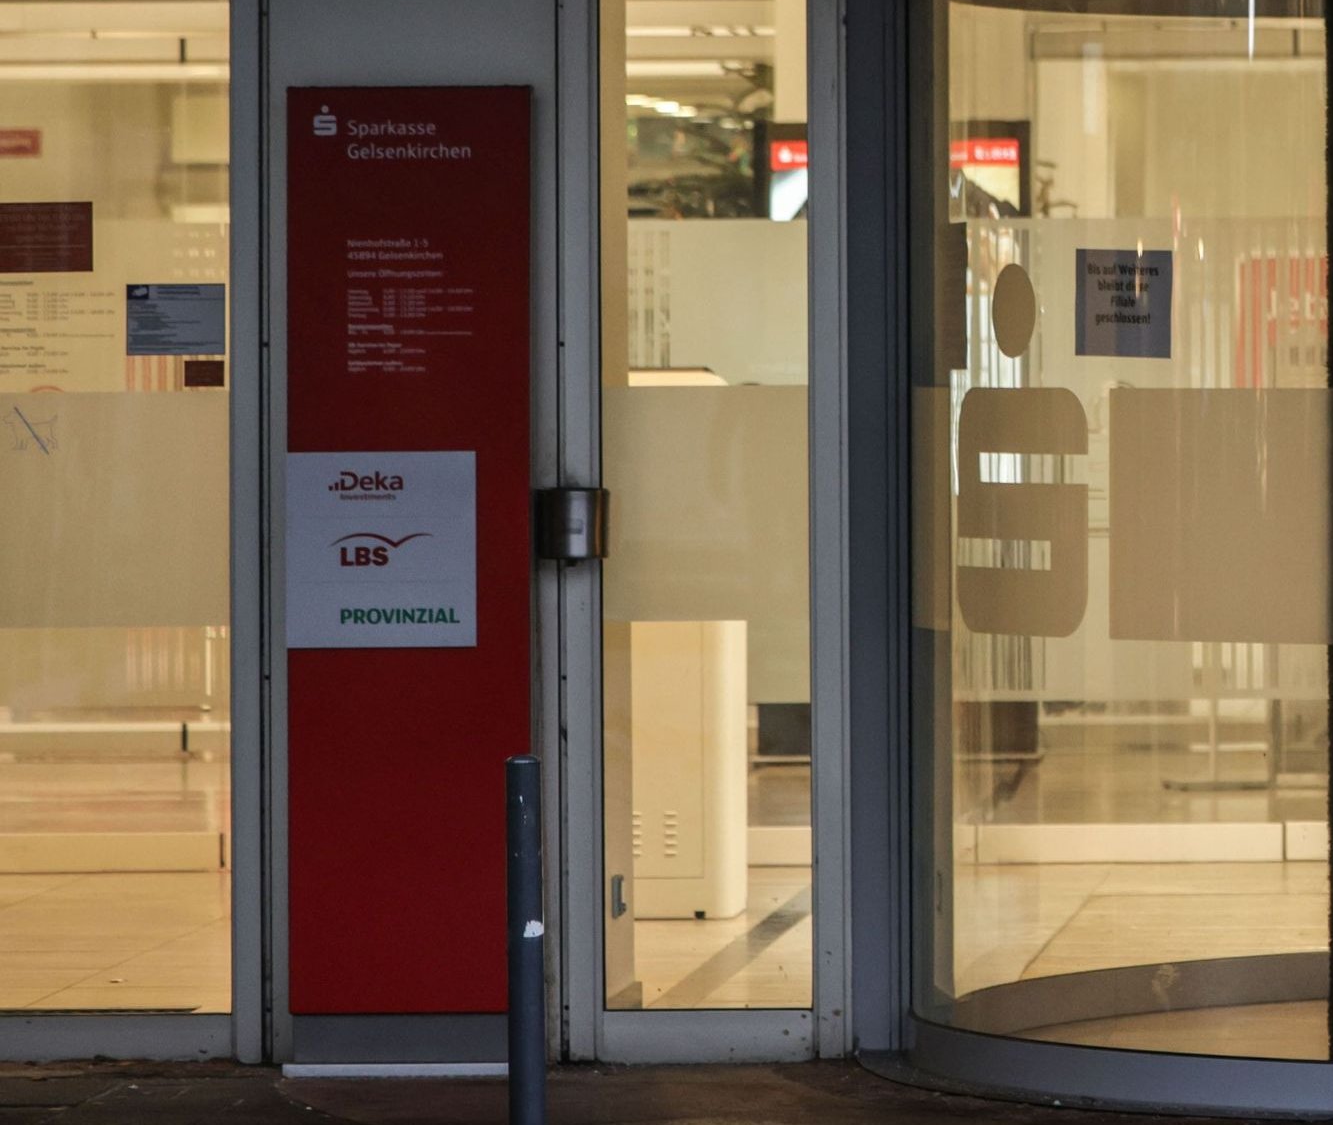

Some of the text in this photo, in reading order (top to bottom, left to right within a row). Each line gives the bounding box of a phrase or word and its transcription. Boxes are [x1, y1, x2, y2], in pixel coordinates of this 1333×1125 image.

[347, 120, 437, 138] Sparkasse
[347, 143, 472, 160] Gelsenkirchen
[1087, 263, 1101, 274] Bis
[1103, 263, 1116, 274] auf
[1097, 279, 1124, 291] bleibt
[1111, 295, 1135, 307] Filiale
[1095, 313, 1151, 326] geschlossen!
[339, 471, 404, 492] Deka
[340, 546, 389, 566] LBS
[340, 607, 461, 624] PROVINZIAL
